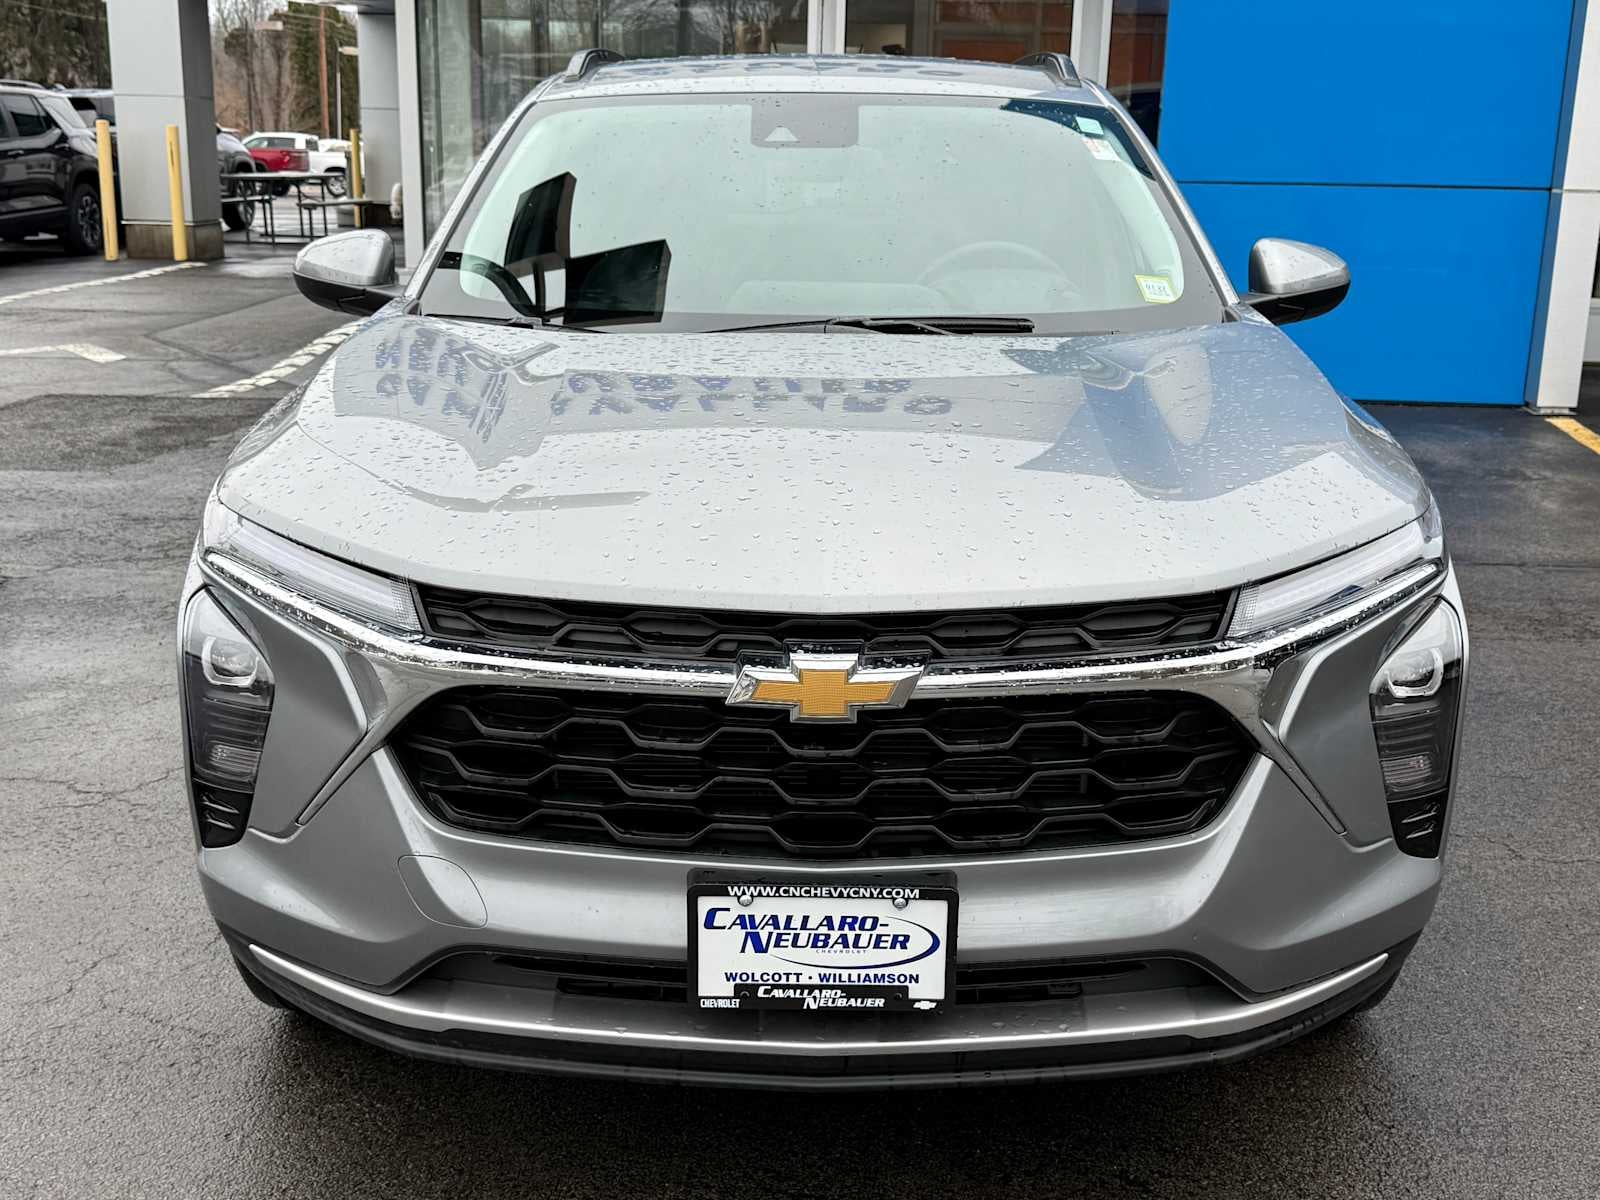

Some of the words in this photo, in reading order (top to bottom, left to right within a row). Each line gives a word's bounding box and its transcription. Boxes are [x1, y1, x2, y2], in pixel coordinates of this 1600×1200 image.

[727, 885, 920, 899] WWW.CNCHEVYCNY.COM
[703, 907, 889, 931] CAVALLARO-
[739, 931, 911, 954] NEUBAUER
[724, 971, 803, 983] WOLCOTT
[818, 972, 920, 984] WILLIAMSON
[757, 985, 846, 999] CAVALLARO-
[700, 998, 741, 1009] CHEVROLET
[803, 997, 885, 1010] NEUBAUER
